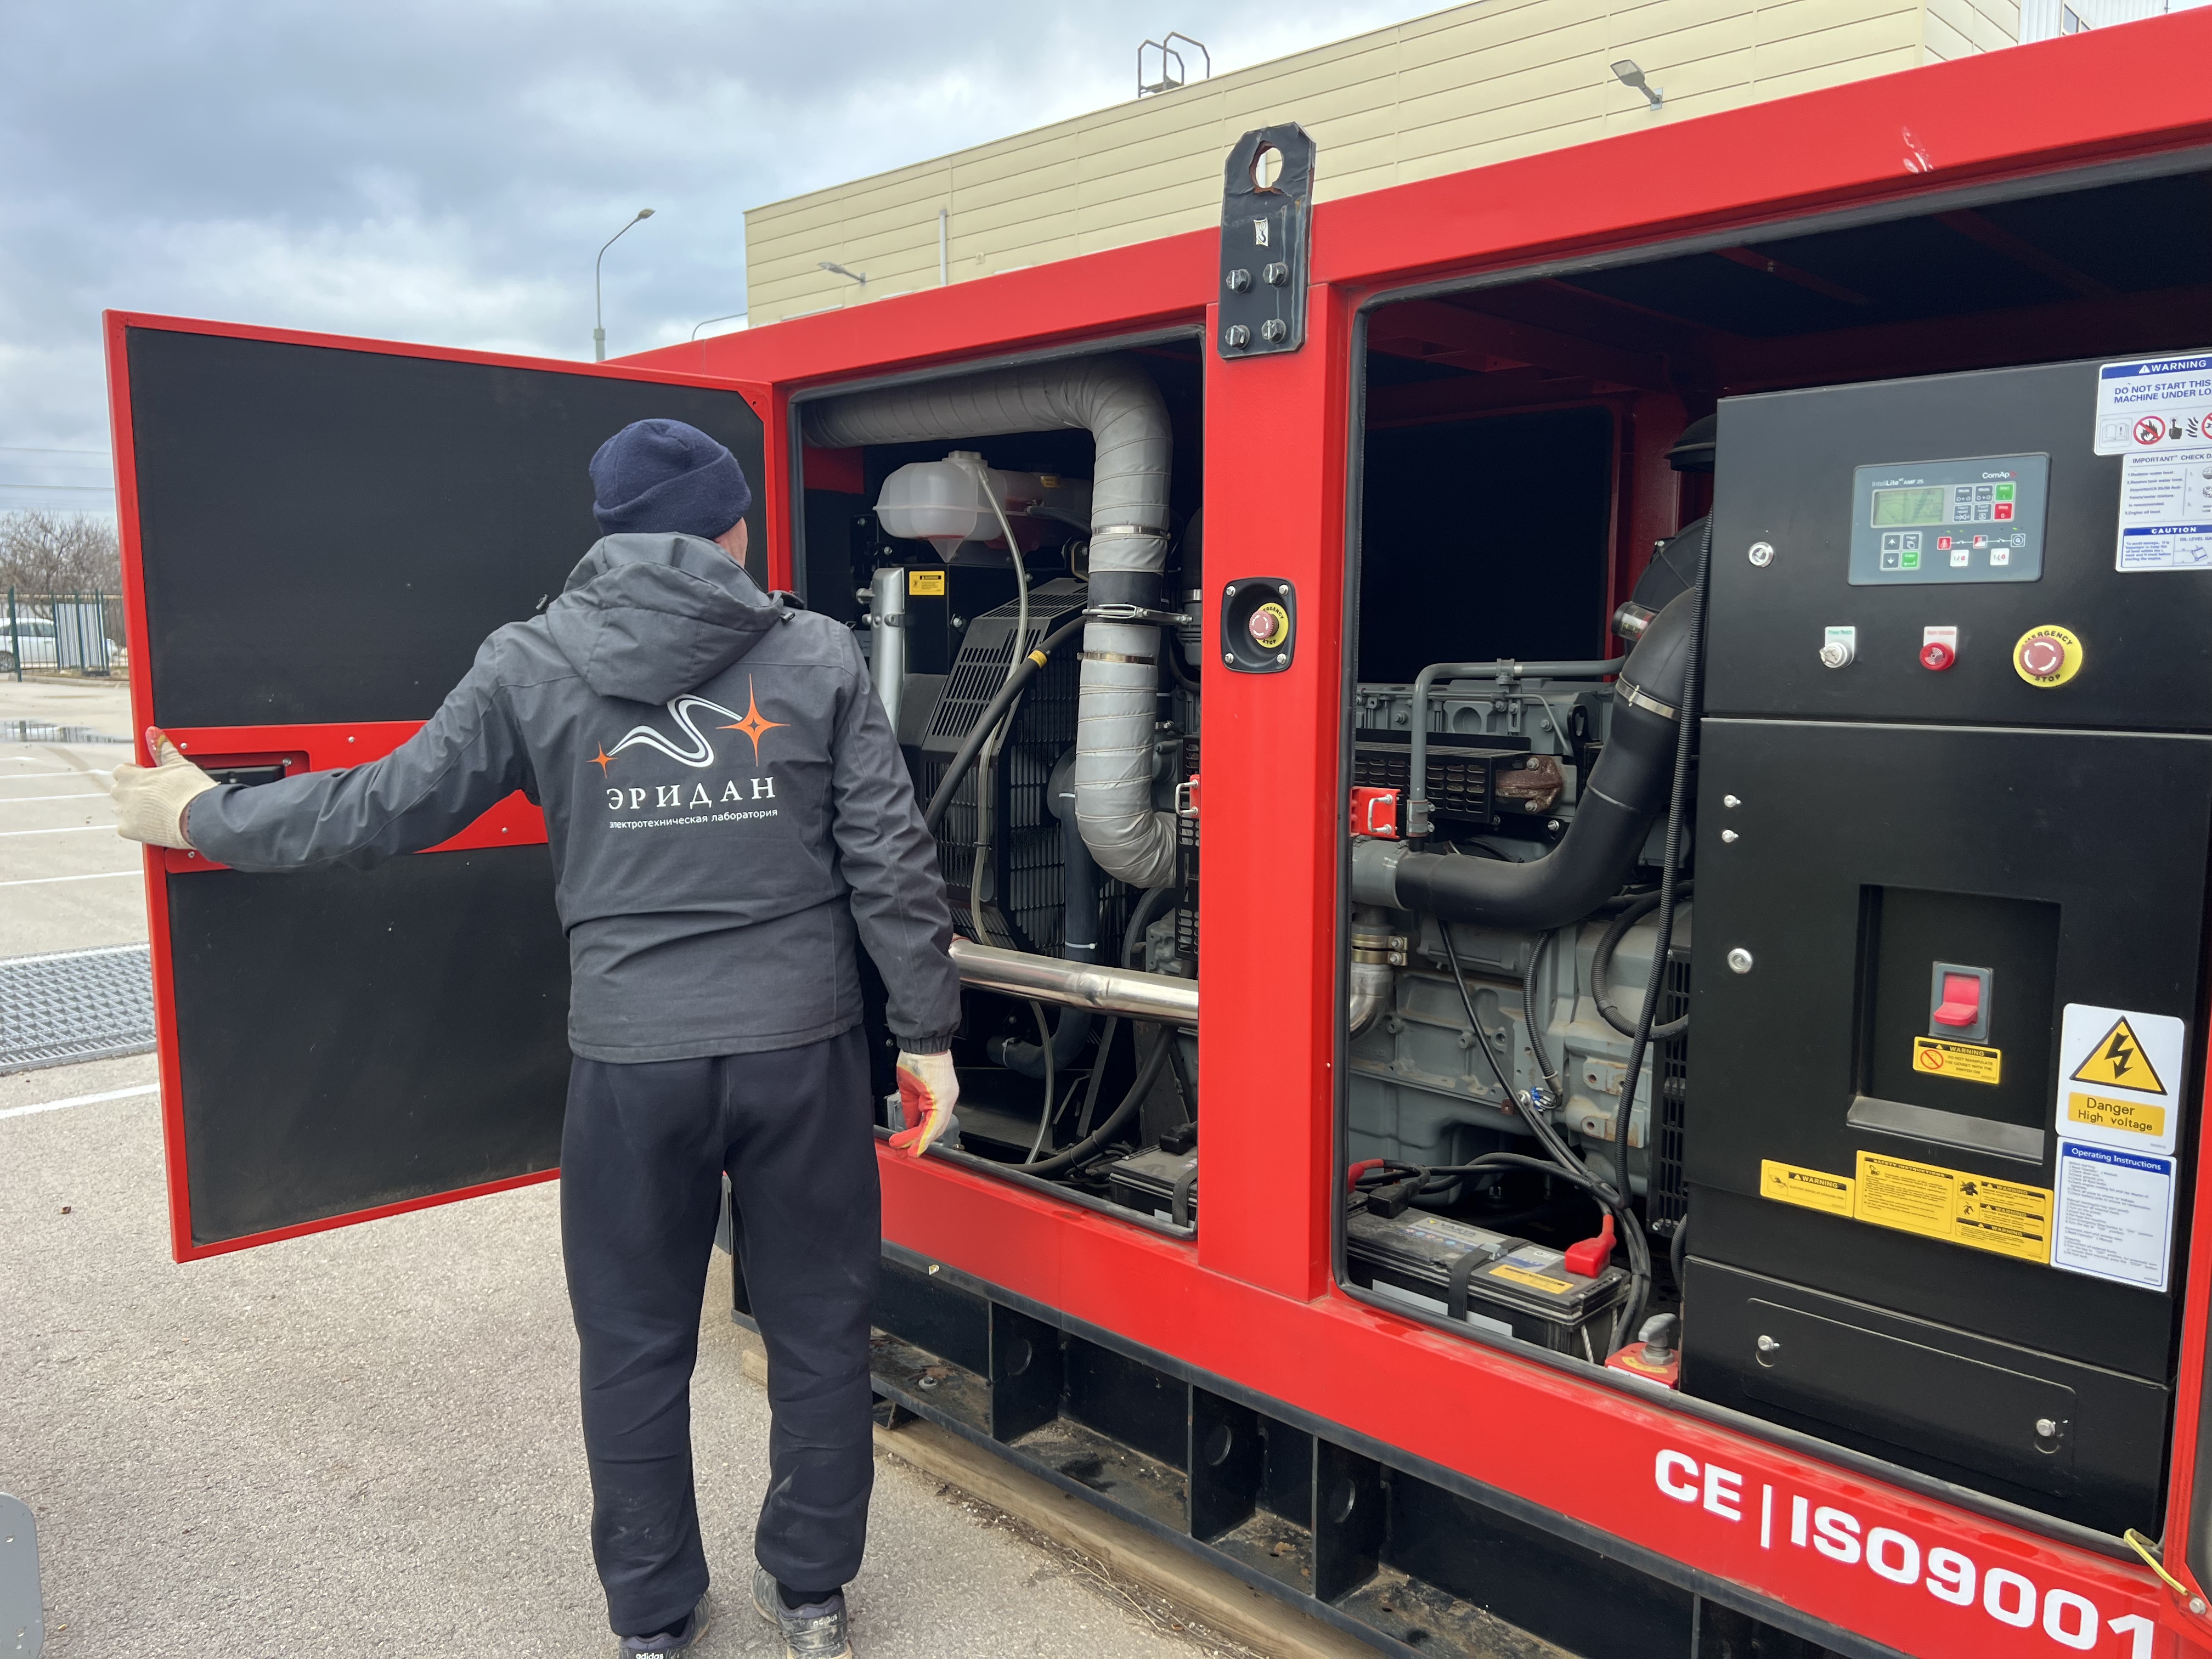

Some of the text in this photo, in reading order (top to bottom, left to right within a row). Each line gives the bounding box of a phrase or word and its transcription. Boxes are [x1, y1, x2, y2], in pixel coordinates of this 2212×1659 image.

[2151, 360, 2207, 371] WARNING
[2131, 385, 2152, 393] NOT
[2154, 382, 2186, 391] START
[2189, 379, 2211, 388] THIS
[2114, 393, 2158, 404] MACHINE
[2162, 390, 2196, 399] UNDER
[606, 776, 776, 810] ЭРИДАН
[609, 809, 778, 830] электротехническая лаборатория
[1949, 1046, 1984, 1056] WARNING
[2087, 1097, 2135, 1115] Danger
[2078, 1109, 2153, 1132] High voltage
[2072, 1147, 2161, 1170] Operating Instructions
[1898, 1165, 1945, 1177] INSTRUCTIONS
[1803, 1176, 1838, 1188] WARNING
[1996, 1185, 2028, 1195] WARNING
[1995, 1207, 2027, 1217] WARNING
[1991, 1226, 2023, 1237] WARNING
[1655, 1449, 1742, 1522] CE
[1791, 1494, 2155, 1659] ISO9001
